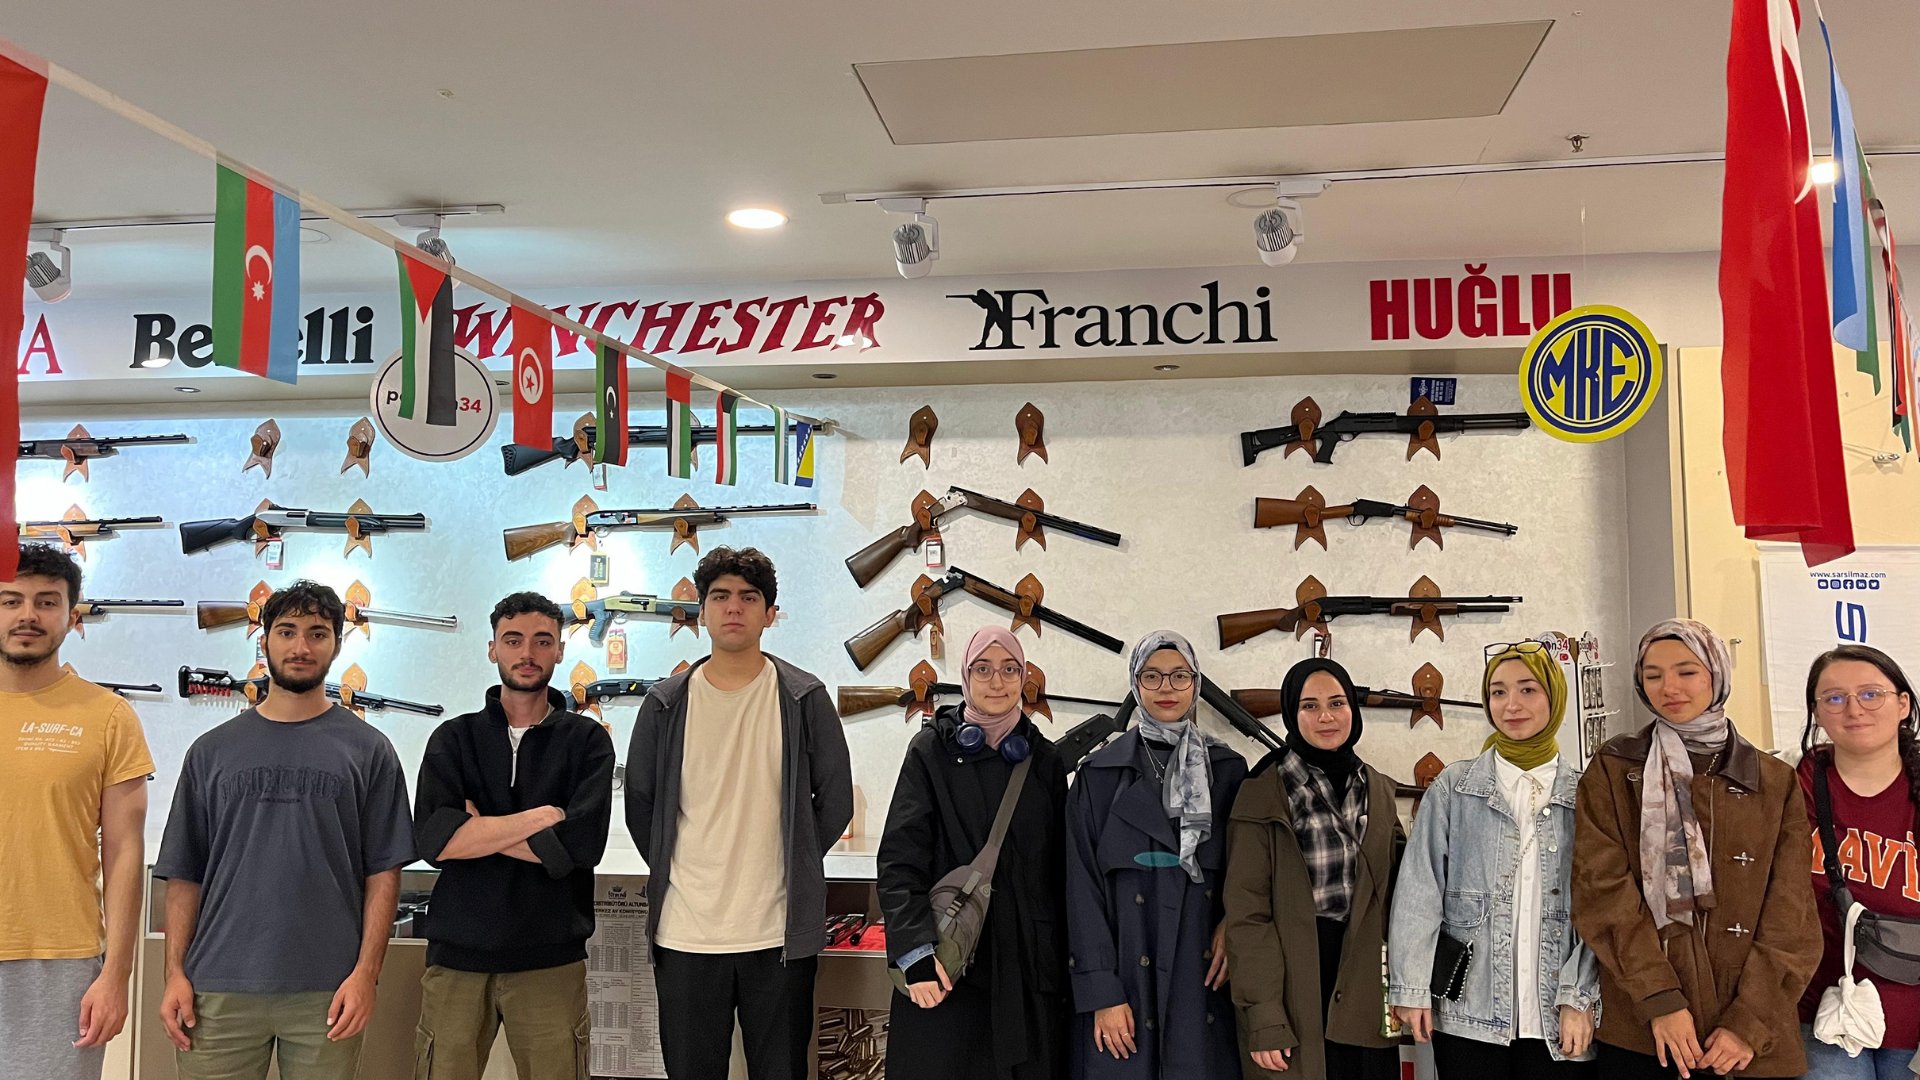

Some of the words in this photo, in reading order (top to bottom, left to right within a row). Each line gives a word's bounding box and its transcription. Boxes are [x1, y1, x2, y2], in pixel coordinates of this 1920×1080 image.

[453, 292, 884, 359] WNCHESTER
[994, 280, 1278, 350] Franchi
[1369, 263, 1572, 340] HUĞLU
[129, 306, 374, 369] Belli
[1542, 328, 1636, 421] MKE
[20, 721, 84, 737] LA-SURF-CA
